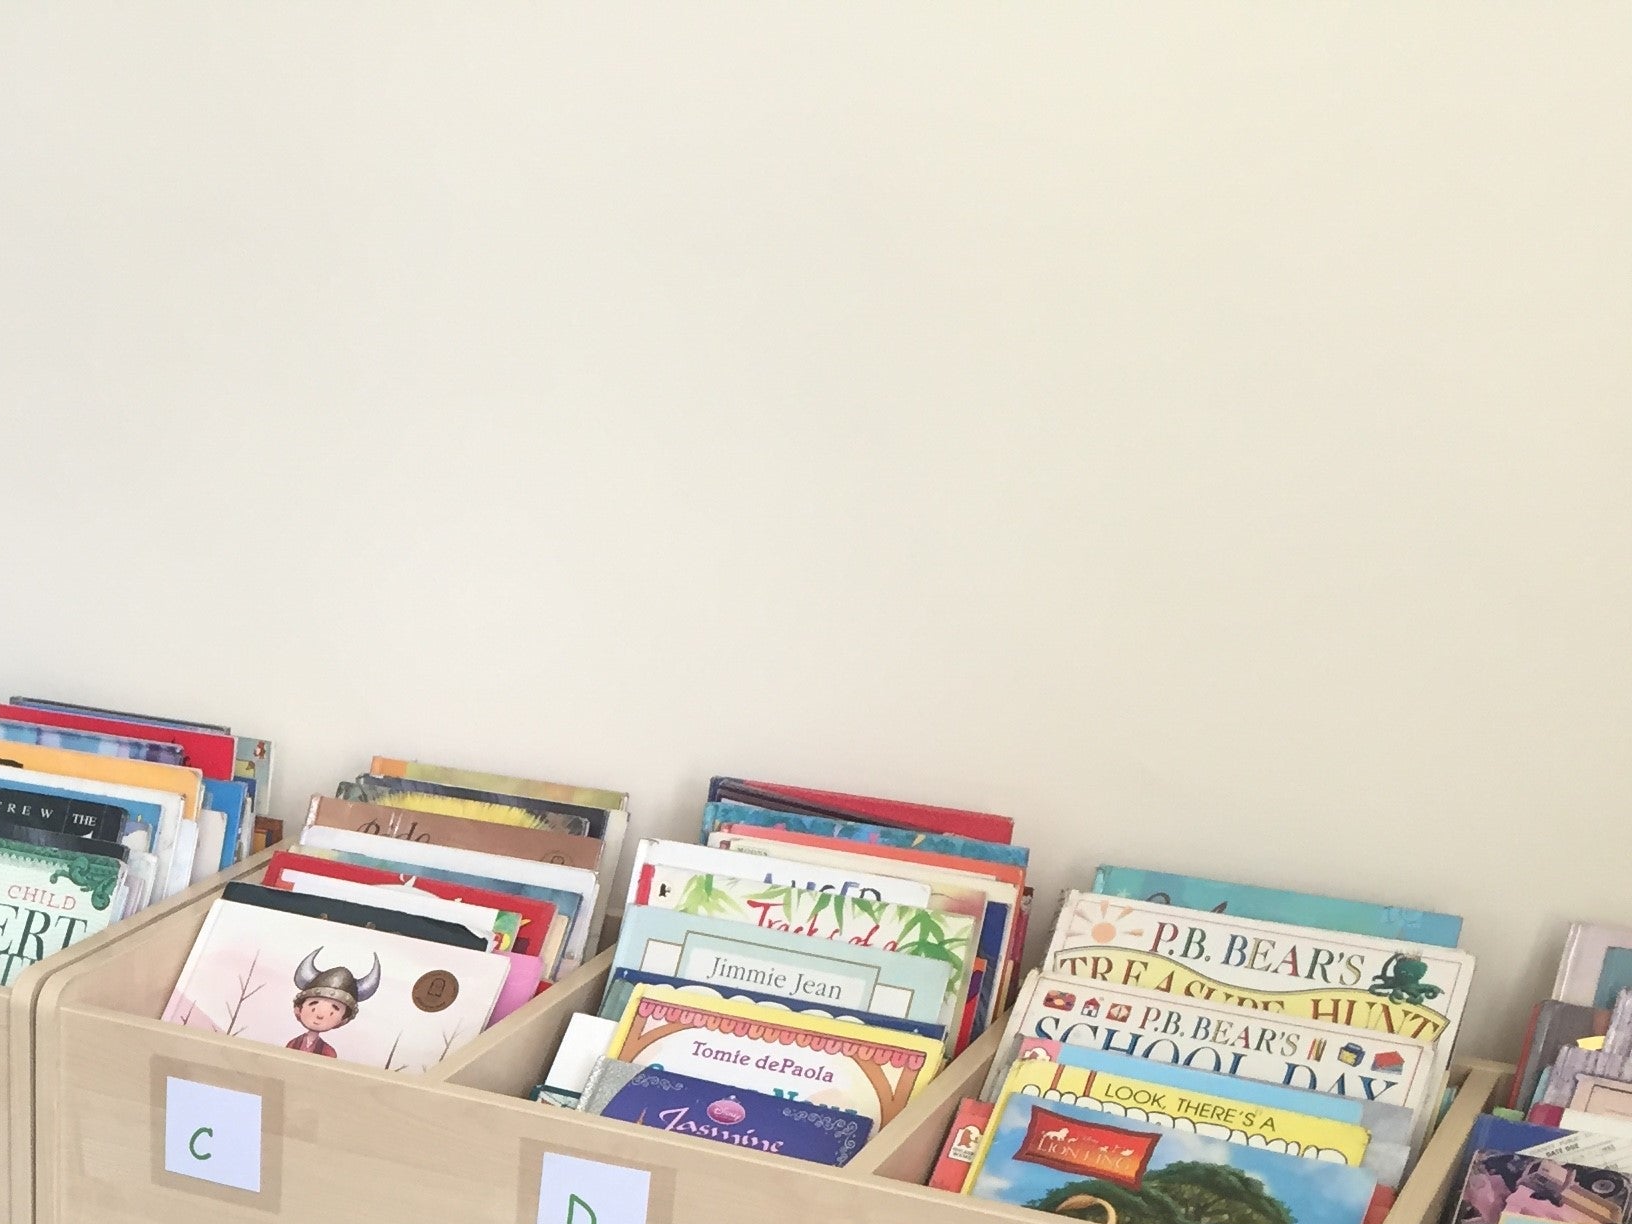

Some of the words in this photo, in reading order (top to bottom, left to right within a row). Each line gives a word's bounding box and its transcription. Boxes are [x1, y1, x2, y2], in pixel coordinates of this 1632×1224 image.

[72, 811, 98, 828] THE
[7, 884, 77, 912] CHILD
[1148, 920, 1212, 963] P.B.
[1220, 933, 1366, 987] BEAR'S
[706, 955, 788, 990] Jimmie
[789, 971, 844, 1002] Jean
[1139, 1005, 1186, 1037] P.B.
[1189, 1014, 1301, 1057] BEAR'S
[691, 1040, 752, 1067] Tomie
[754, 1054, 835, 1084] dePaola
[658, 1106, 785, 1153] Jasmine
[1104, 1083, 1167, 1111] LOOK,
[1177, 1096, 1255, 1128] THERE'S
[1258, 1115, 1277, 1132] A
[188, 1126, 214, 1161] C
